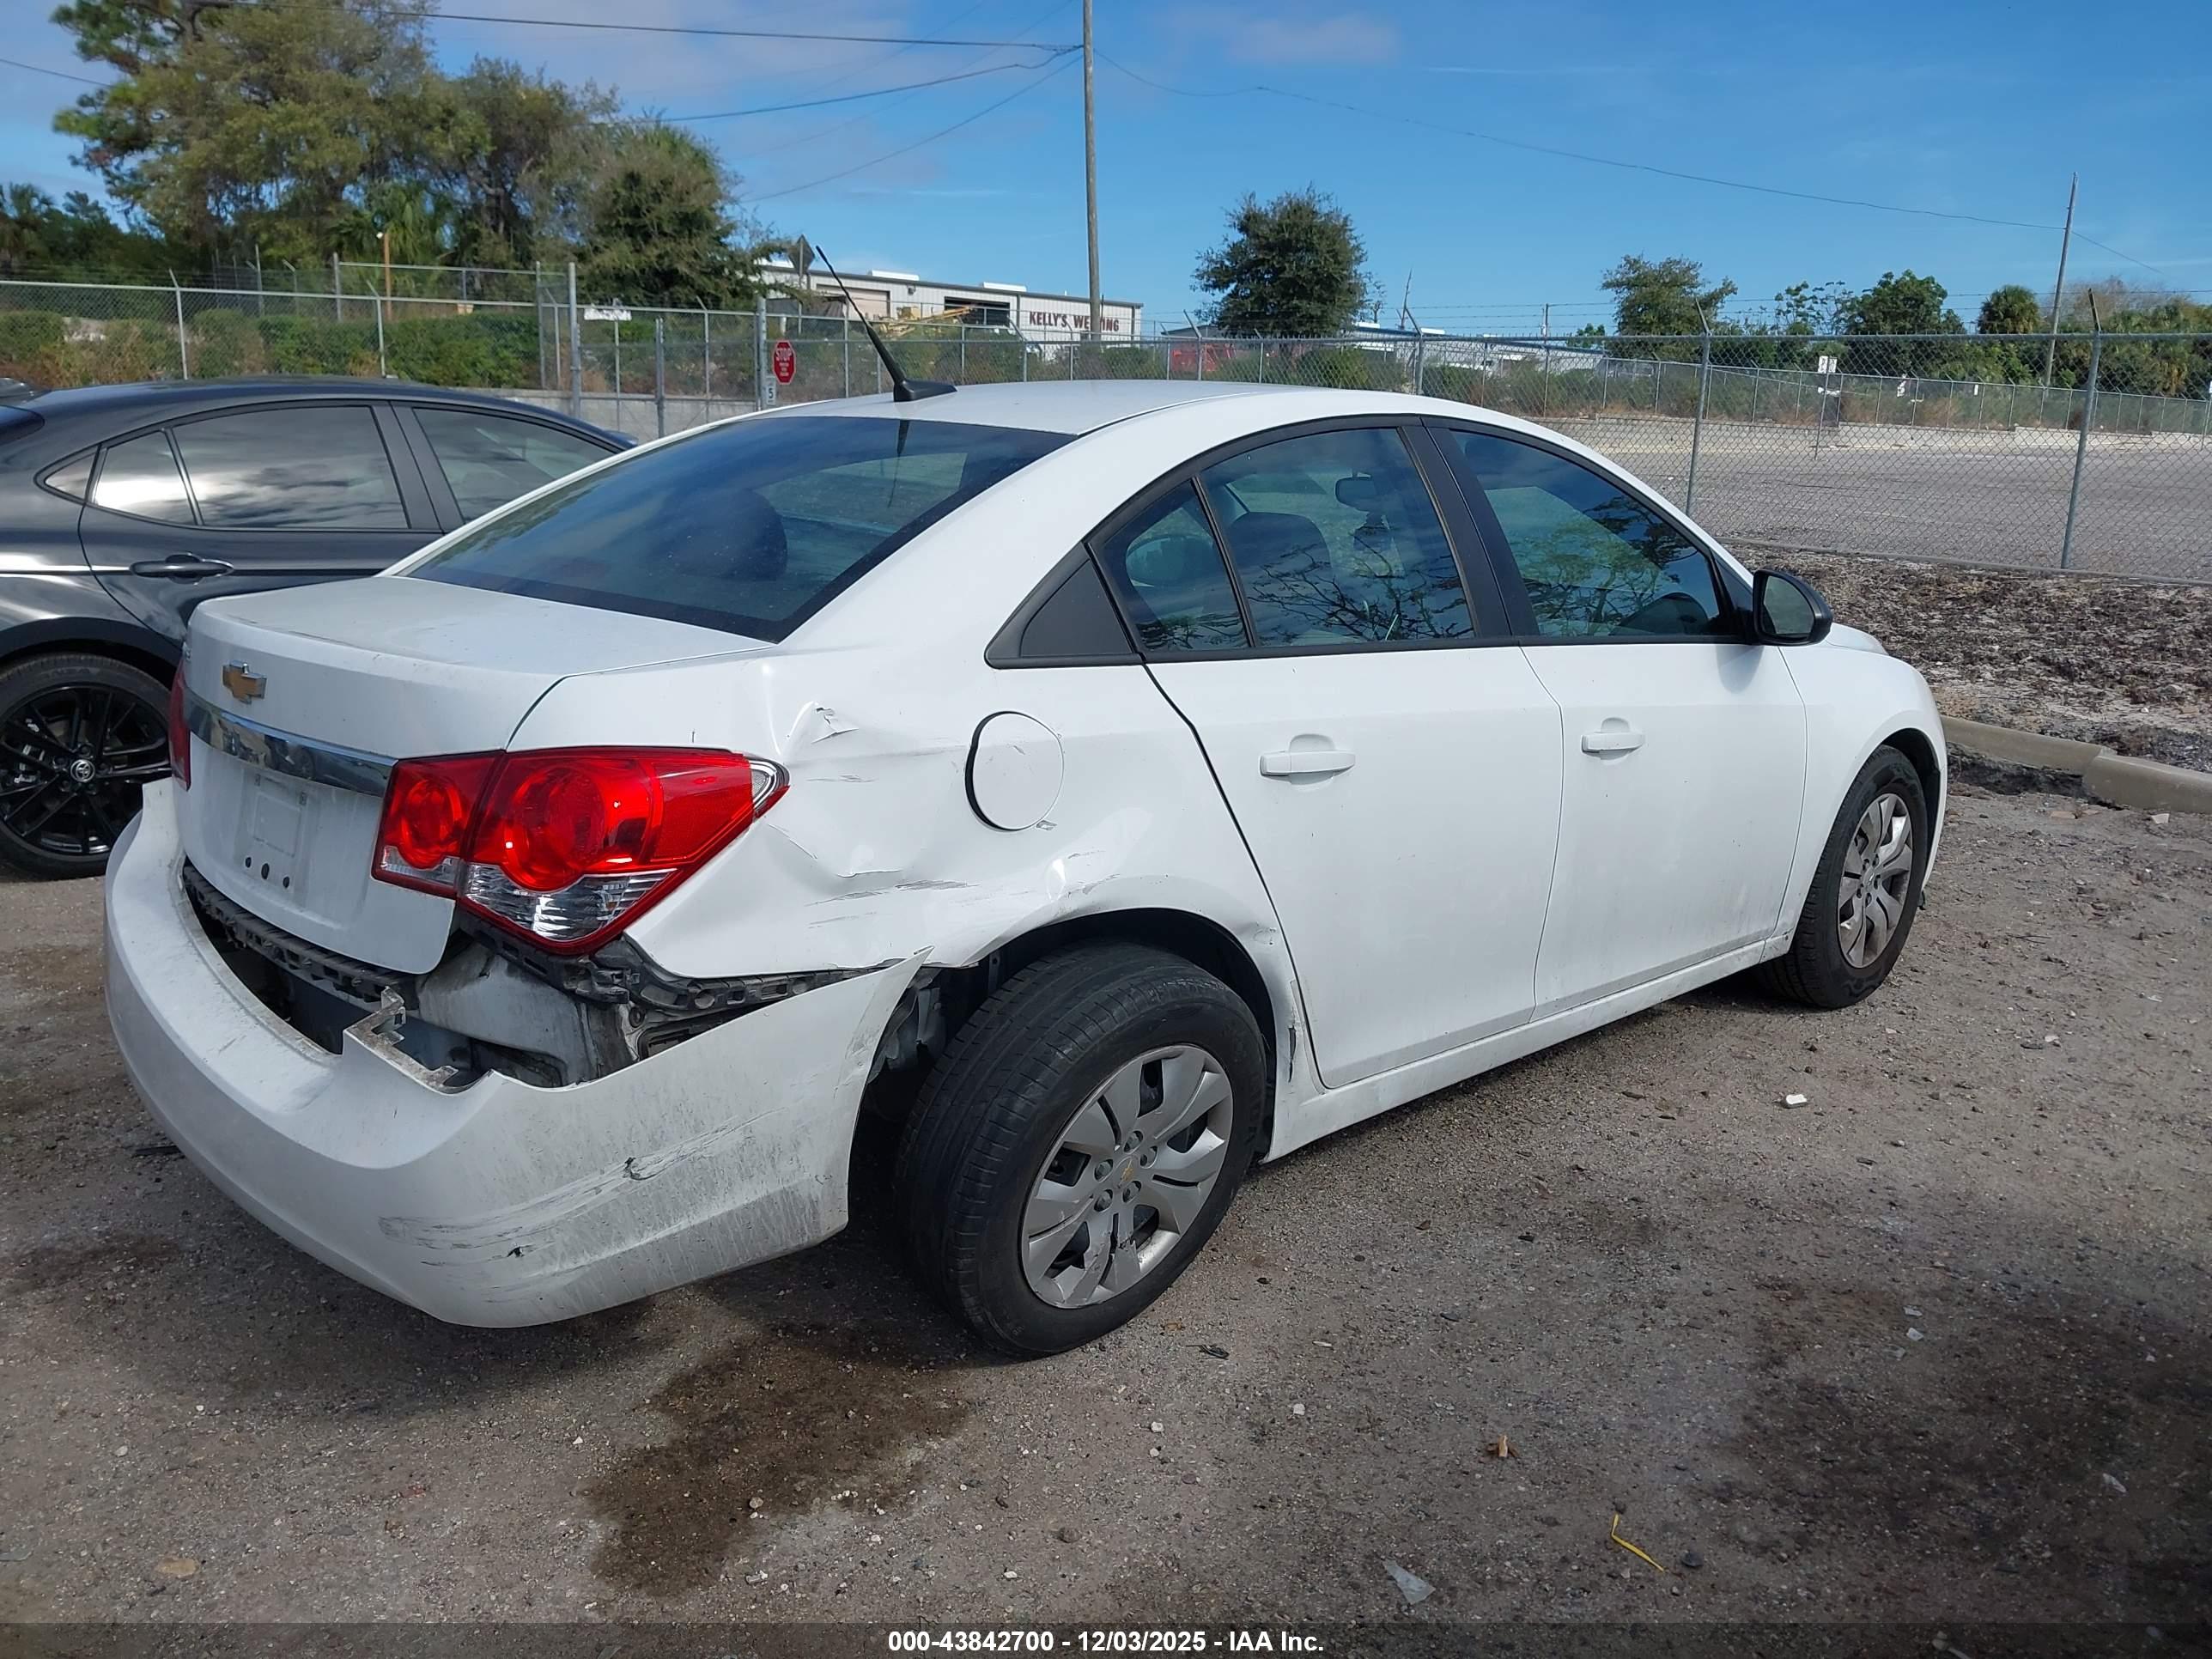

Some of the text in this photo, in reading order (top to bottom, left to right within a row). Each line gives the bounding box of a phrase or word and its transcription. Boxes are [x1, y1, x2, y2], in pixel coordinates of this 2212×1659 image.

[1030, 311, 1120, 332] KELLY'S WEING
[775, 348, 792, 362] STOP
[769, 387, 774, 399] 5
